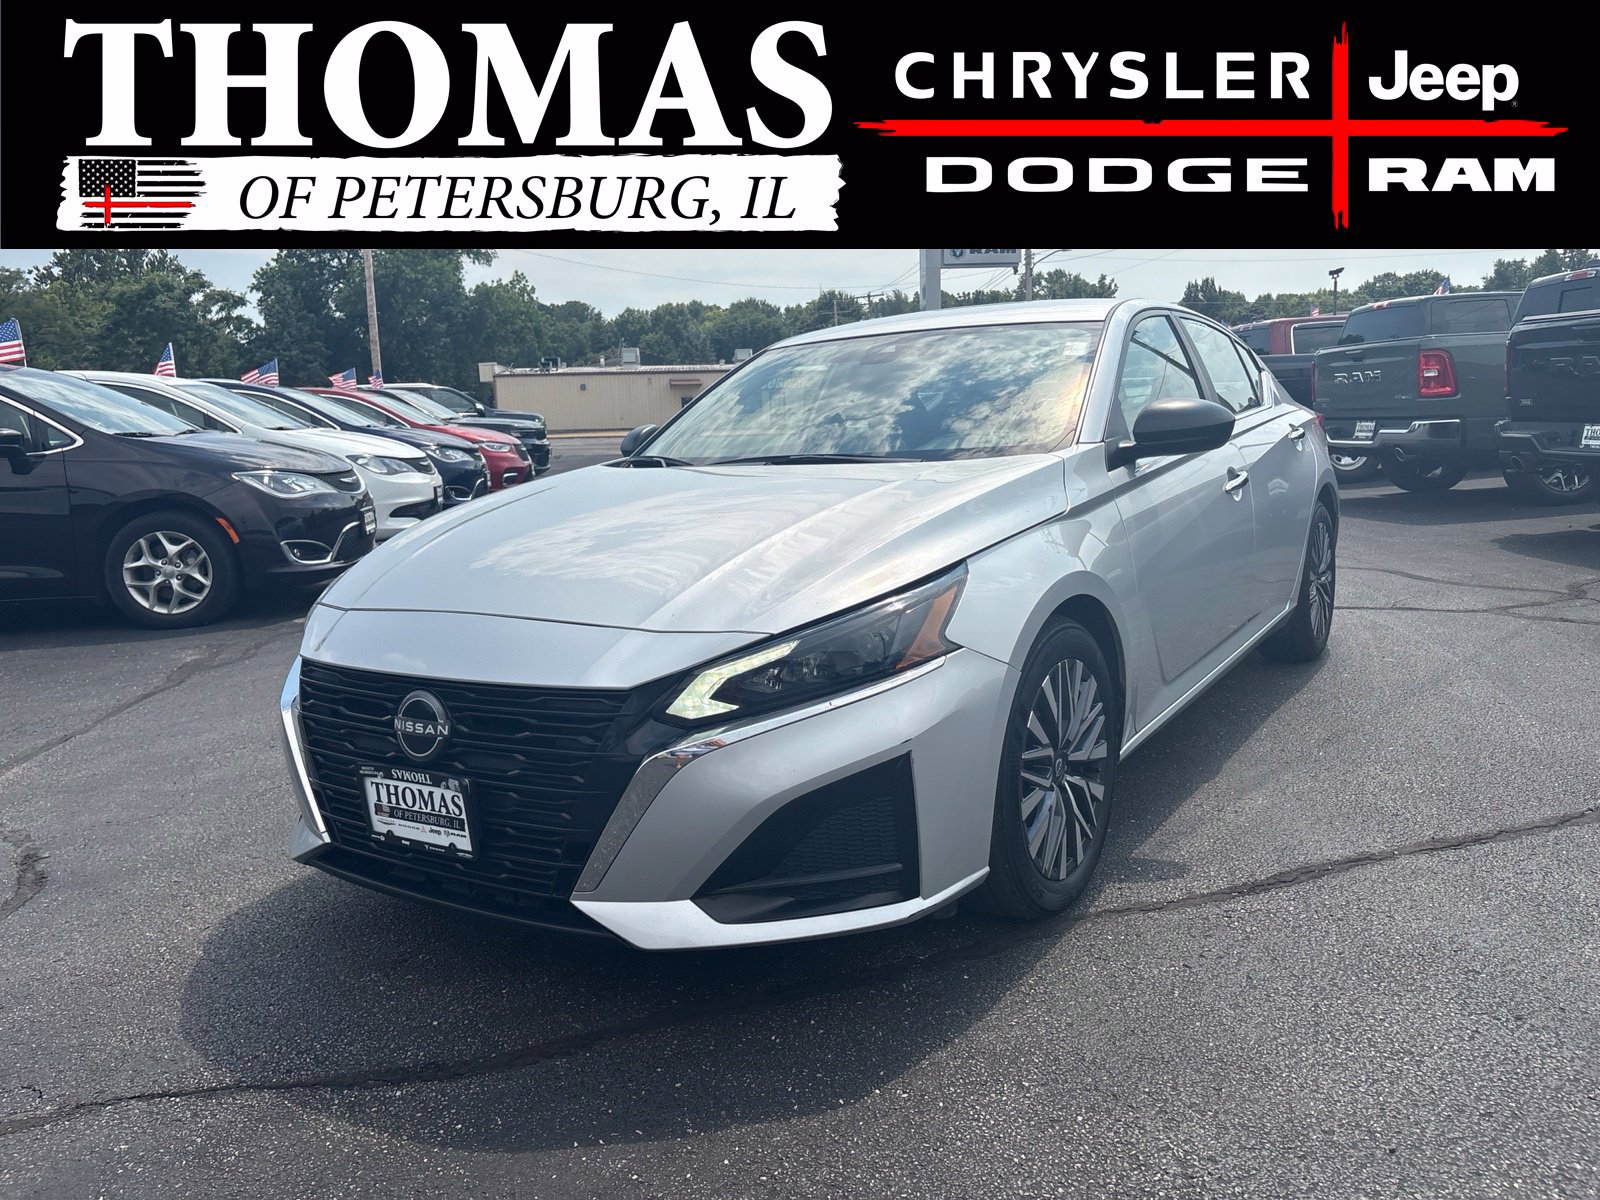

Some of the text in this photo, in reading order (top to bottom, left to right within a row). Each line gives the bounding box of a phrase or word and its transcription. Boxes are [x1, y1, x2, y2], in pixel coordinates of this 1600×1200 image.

[1333, 370, 1381, 383] RAM
[394, 718, 449, 735] NISSAN
[391, 768, 433, 784] THOMAS
[370, 781, 463, 817] THOMAS
[394, 809, 404, 818] OF
[405, 810, 452, 828] PETERSBURG,
[453, 820, 461, 829] IL
[428, 827, 442, 836] Jeep
